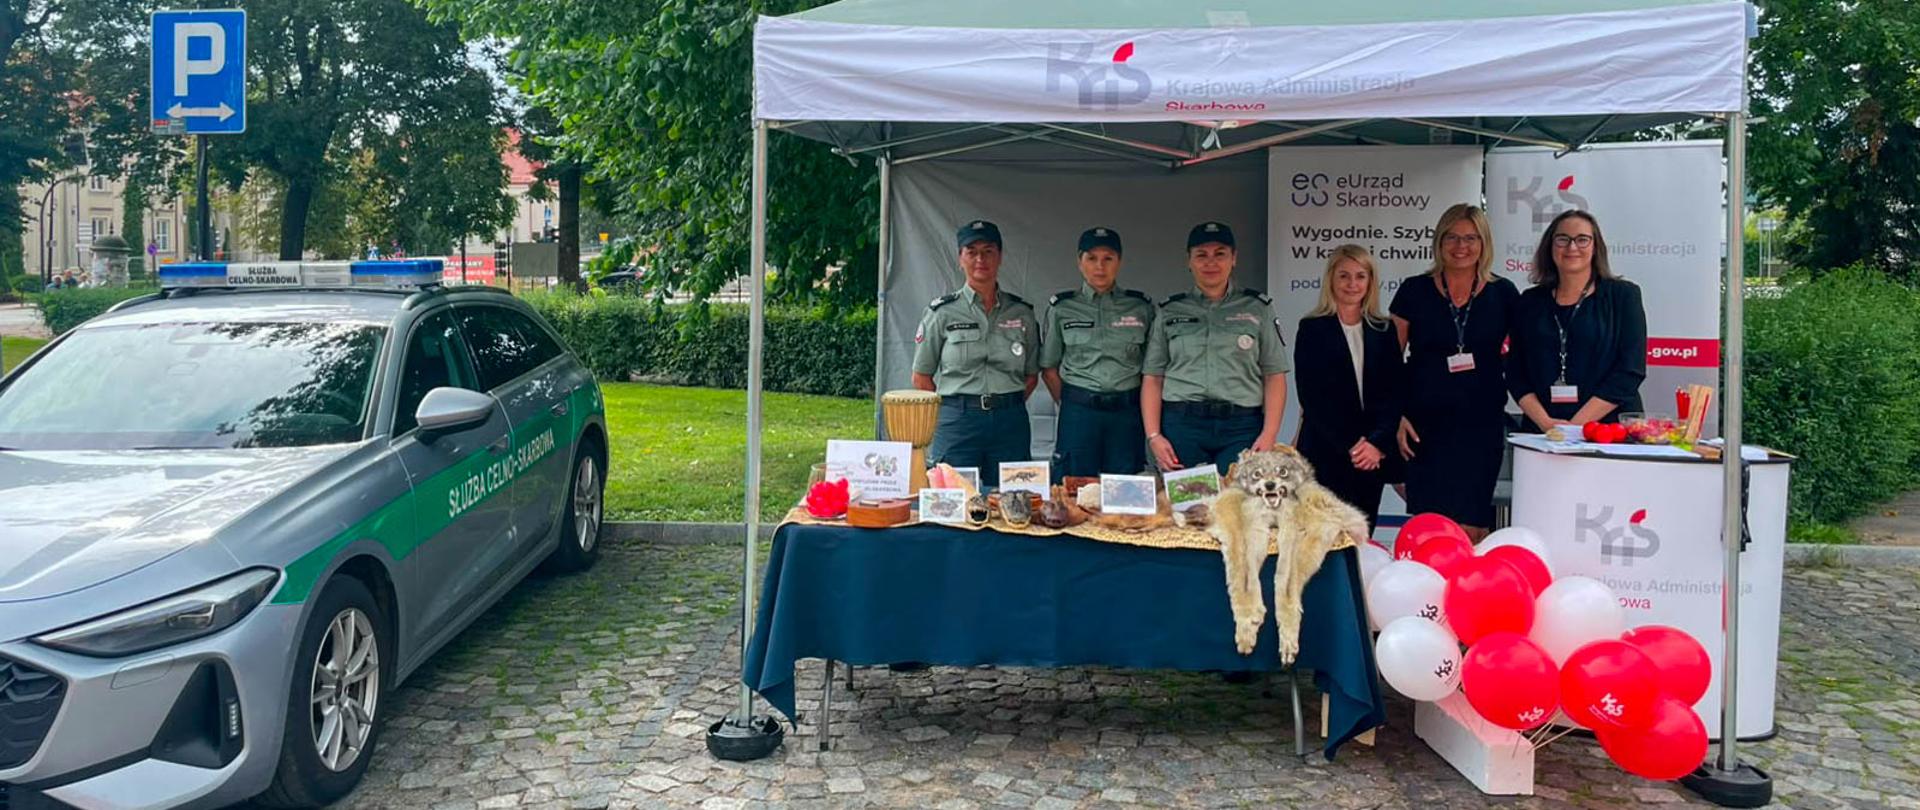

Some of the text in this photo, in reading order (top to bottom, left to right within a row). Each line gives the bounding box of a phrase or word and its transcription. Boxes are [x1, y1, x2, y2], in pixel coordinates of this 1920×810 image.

[174, 22, 226, 97] P
[1166, 74, 1415, 96] Krajowa Administracja
[1336, 173, 1404, 192] eUrząd
[1336, 192, 1430, 211] Skarbowy
[1292, 225, 1434, 241] Wygodnie. Szyb
[1292, 247, 1311, 259] W
[228, 276, 298, 284] CELNO-SKARBOWA
[248, 266, 277, 275] SŁUŻBA
[449, 427, 555, 518] SŁUŻBA CELNO-SKARBOWA
